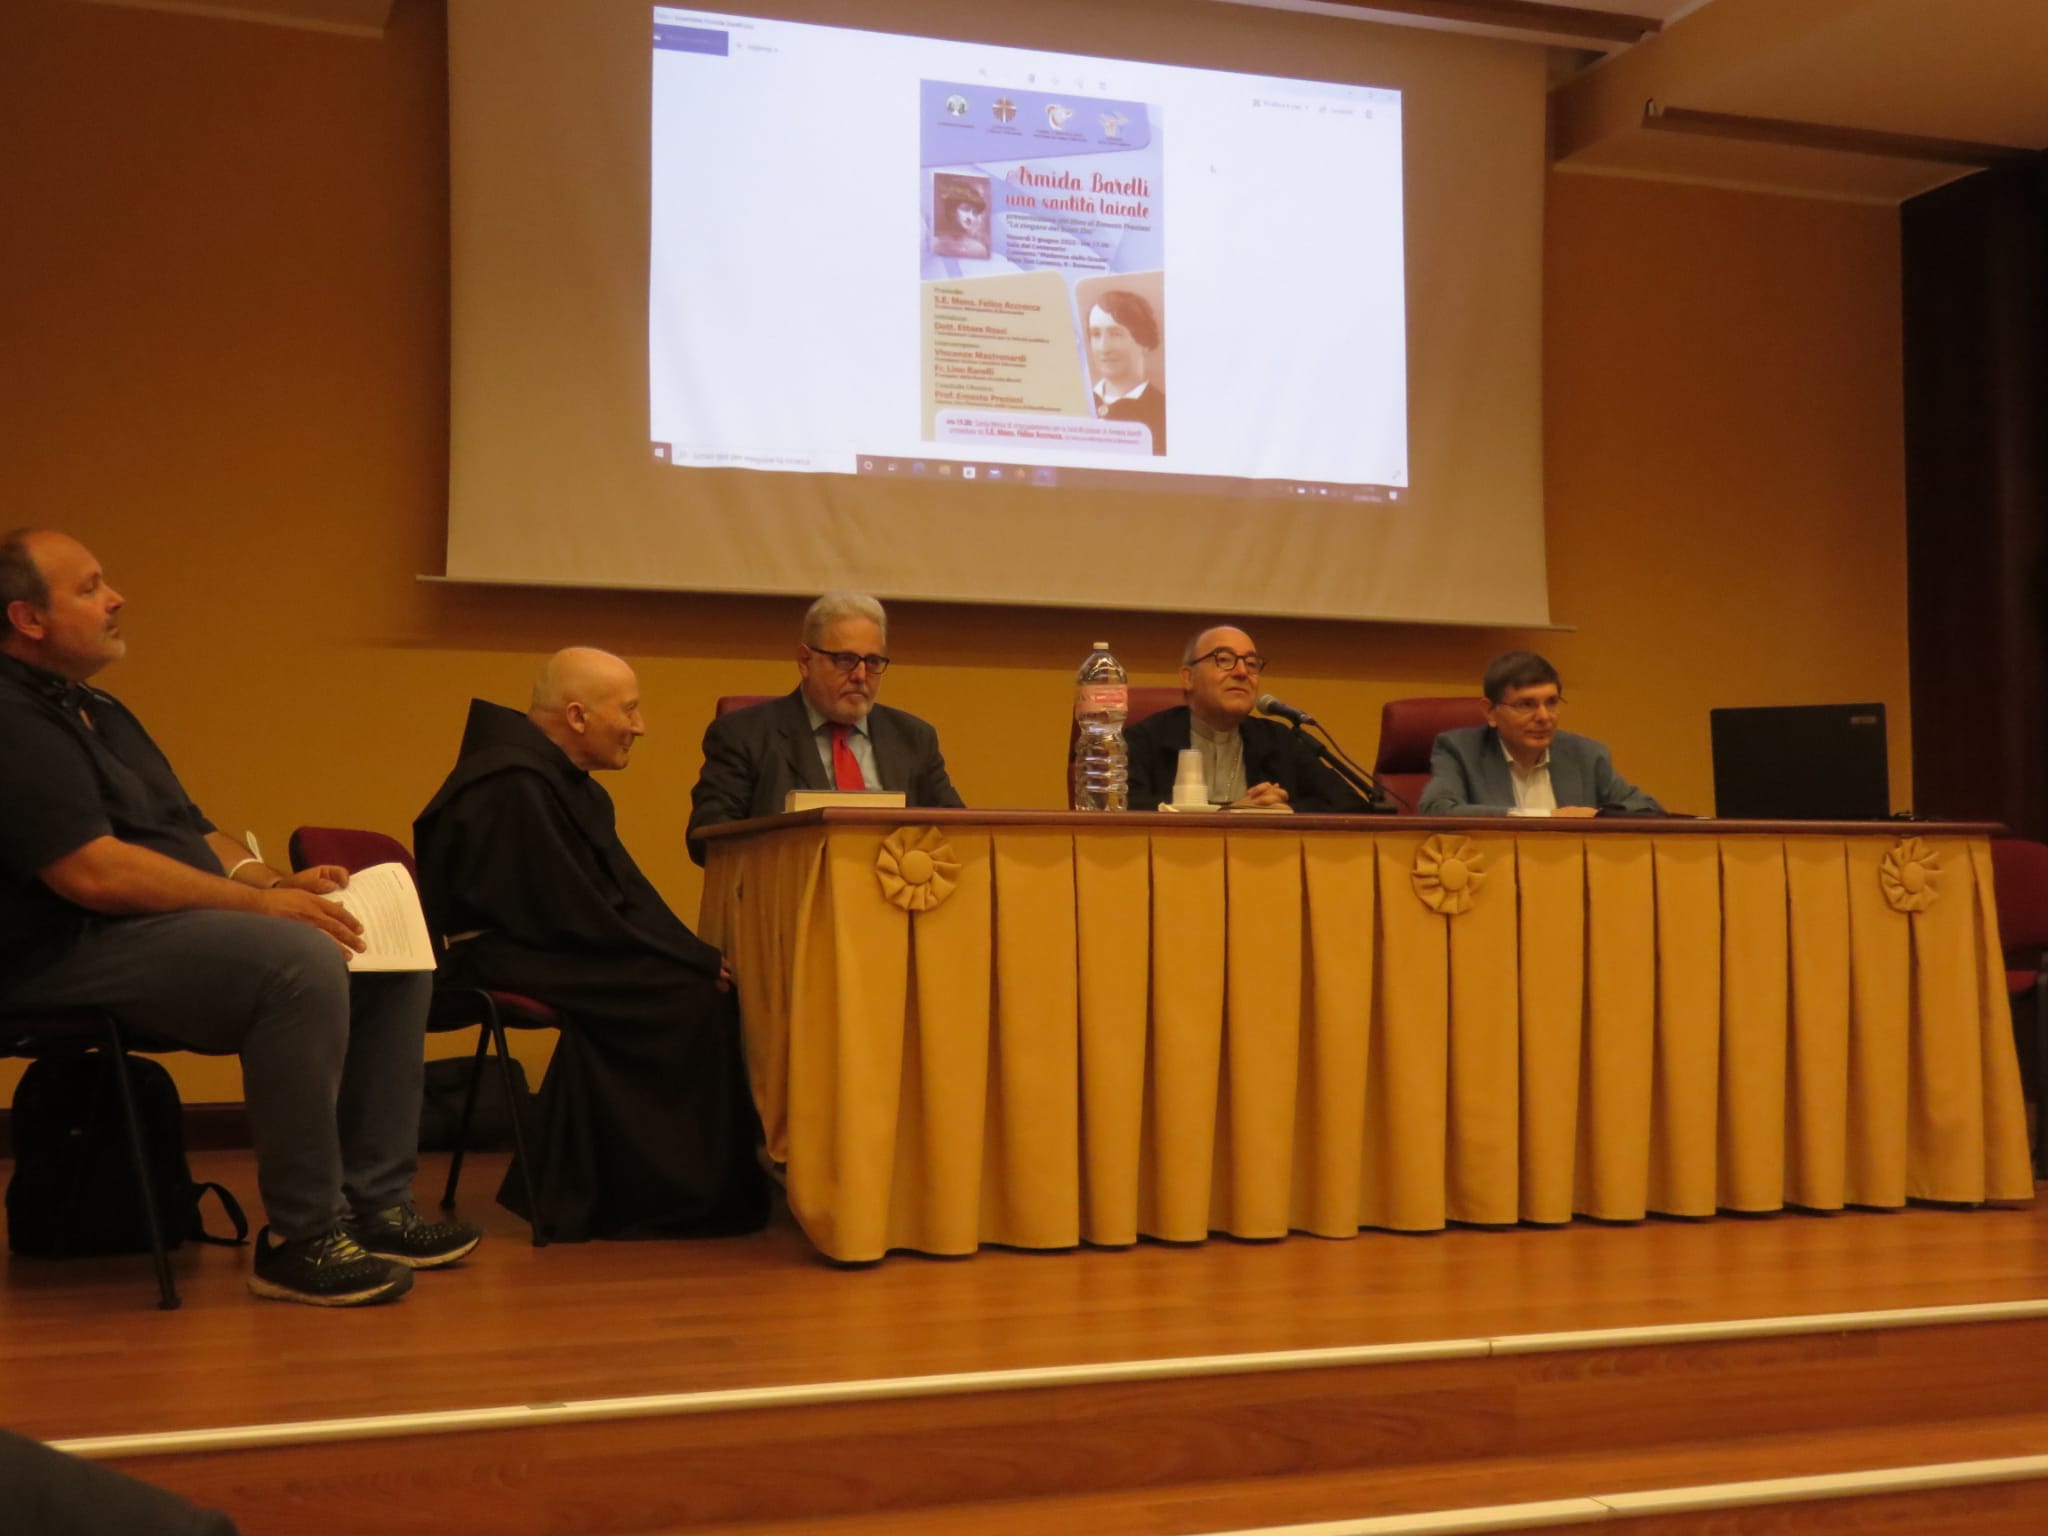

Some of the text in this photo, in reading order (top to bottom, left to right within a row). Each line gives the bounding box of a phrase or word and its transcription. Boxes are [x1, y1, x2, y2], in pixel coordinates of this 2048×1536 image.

[1005, 166, 1150, 198] Armida Barelli
[1006, 194, 1150, 218] una santità laicale
